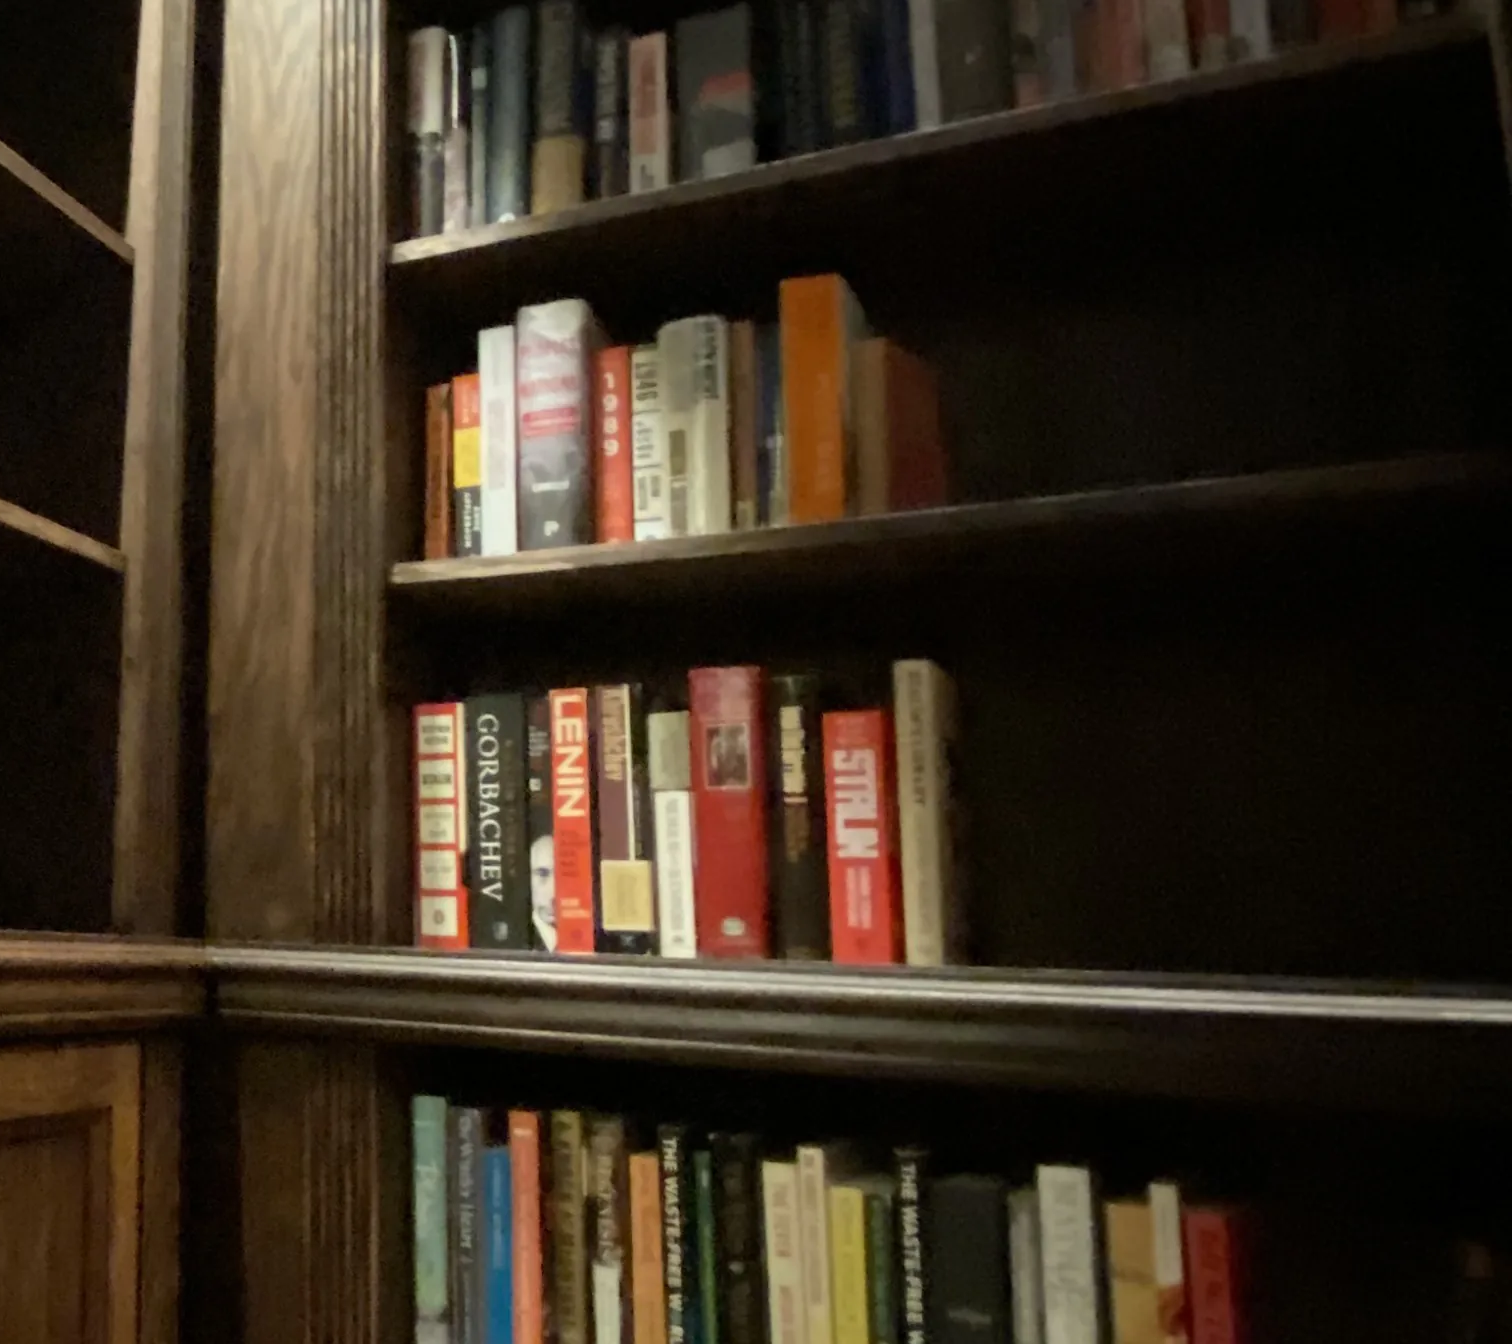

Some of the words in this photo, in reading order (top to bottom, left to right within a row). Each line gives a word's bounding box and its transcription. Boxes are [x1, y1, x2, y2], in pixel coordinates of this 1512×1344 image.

[603, 371, 619, 457] 1989
[476, 714, 504, 902] GORBACHEV
[552, 694, 586, 818] LENIN
[832, 748, 879, 859] STALIN
[662, 1137, 679, 1173] THE
[900, 1163, 918, 1200] THE
[663, 1174, 684, 1289] WASTE-FREE
[902, 1205, 925, 1325] WASTE-FREE
